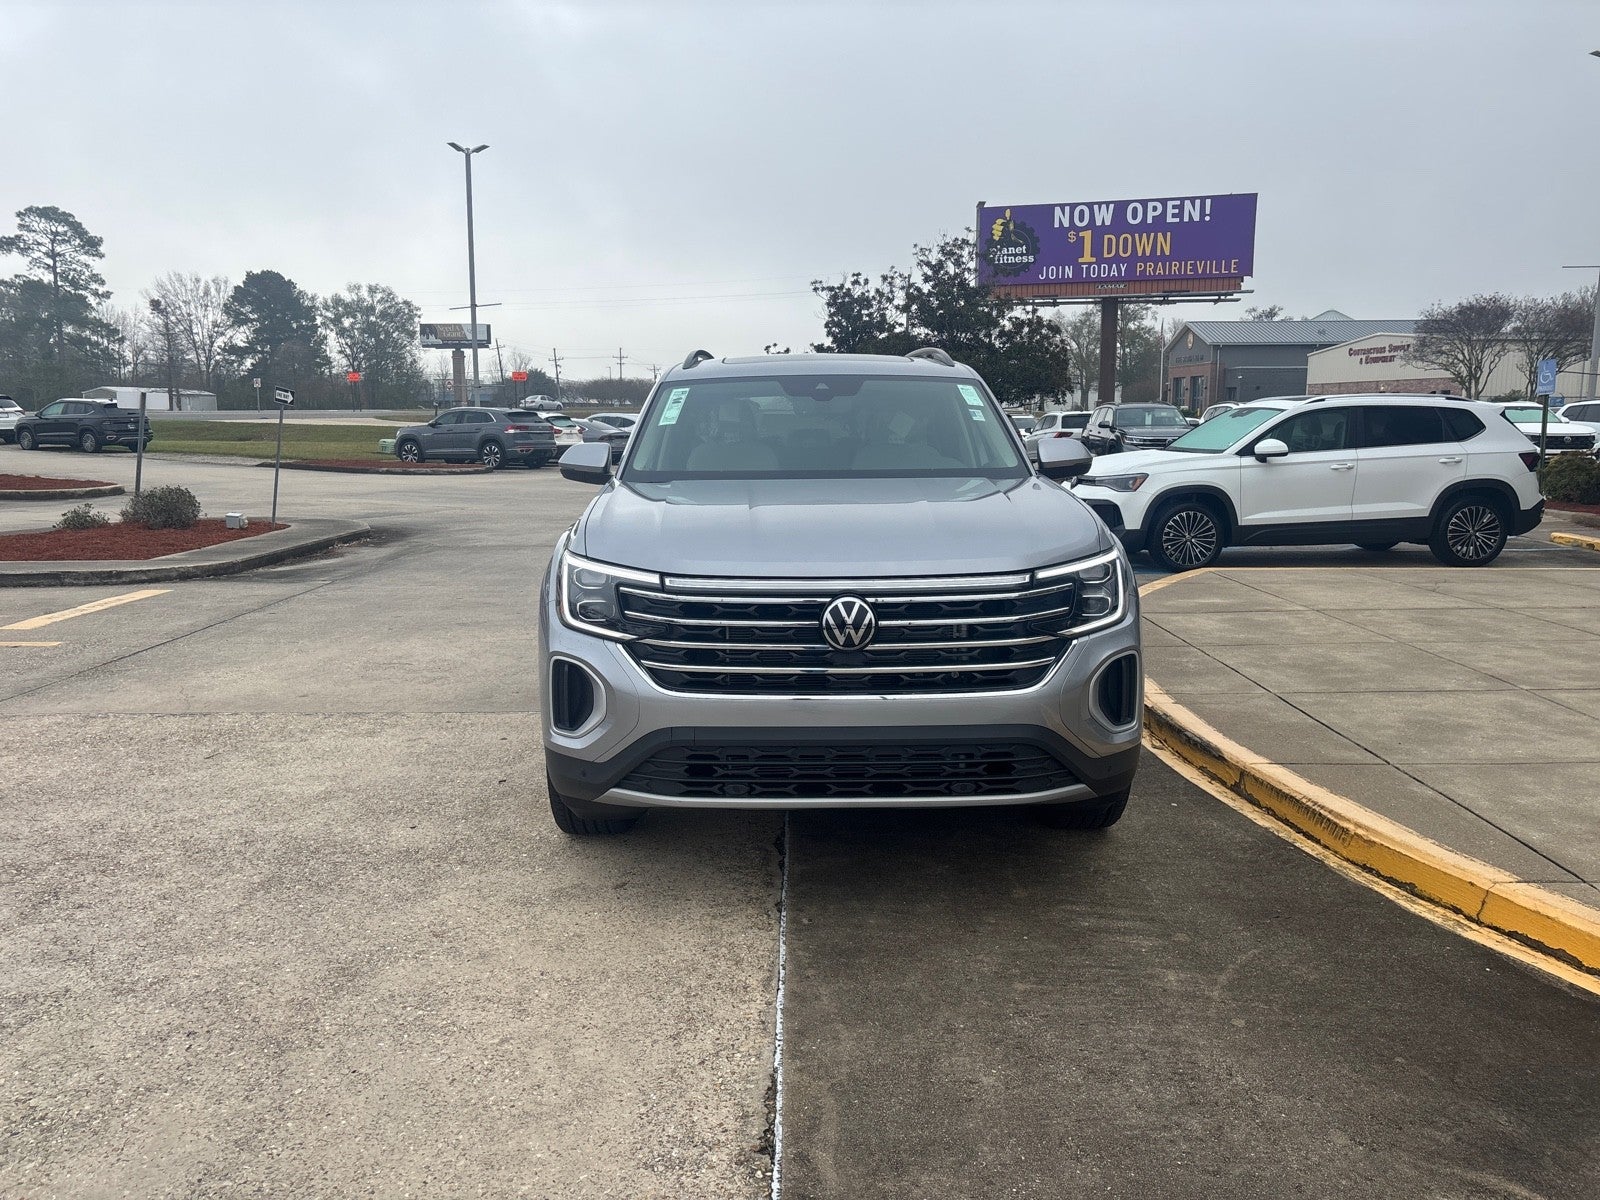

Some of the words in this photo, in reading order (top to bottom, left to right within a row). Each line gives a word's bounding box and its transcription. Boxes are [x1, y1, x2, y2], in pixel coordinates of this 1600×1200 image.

[1054, 204, 1114, 228] NOW
[1126, 199, 1211, 224] OPEN!
[1103, 232, 1171, 258] DOWN
[1039, 265, 1073, 279] JOIN
[1081, 263, 1127, 278] TODAY
[1136, 259, 1239, 276] PRAIRIEVILLE
